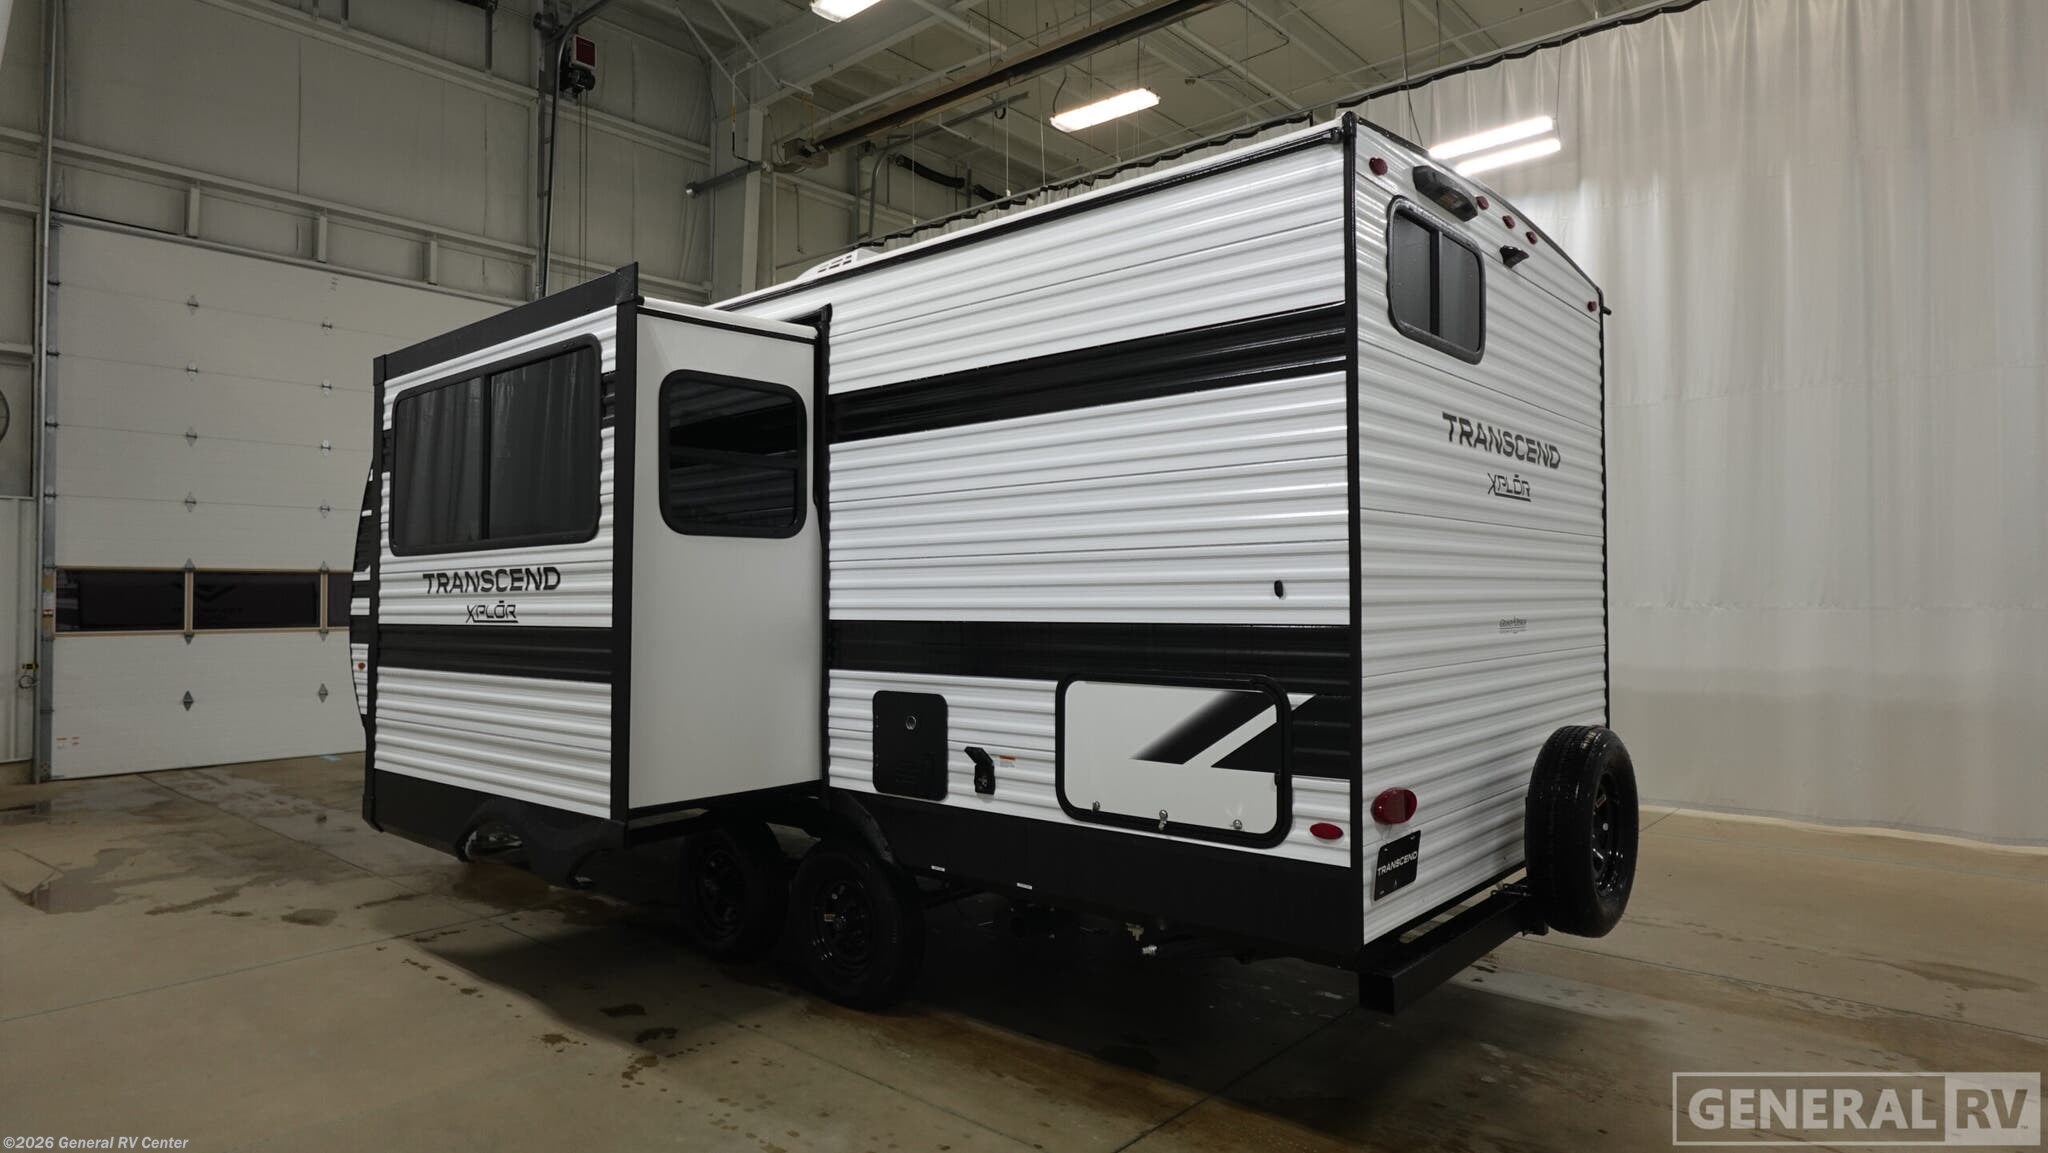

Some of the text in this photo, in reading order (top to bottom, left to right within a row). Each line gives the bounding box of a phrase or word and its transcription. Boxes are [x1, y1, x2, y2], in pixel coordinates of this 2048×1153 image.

[1442, 411, 1561, 469] TRANSCEND
[422, 566, 561, 594] TRANSCEND
[1377, 851, 1418, 876] TRANSCEND
